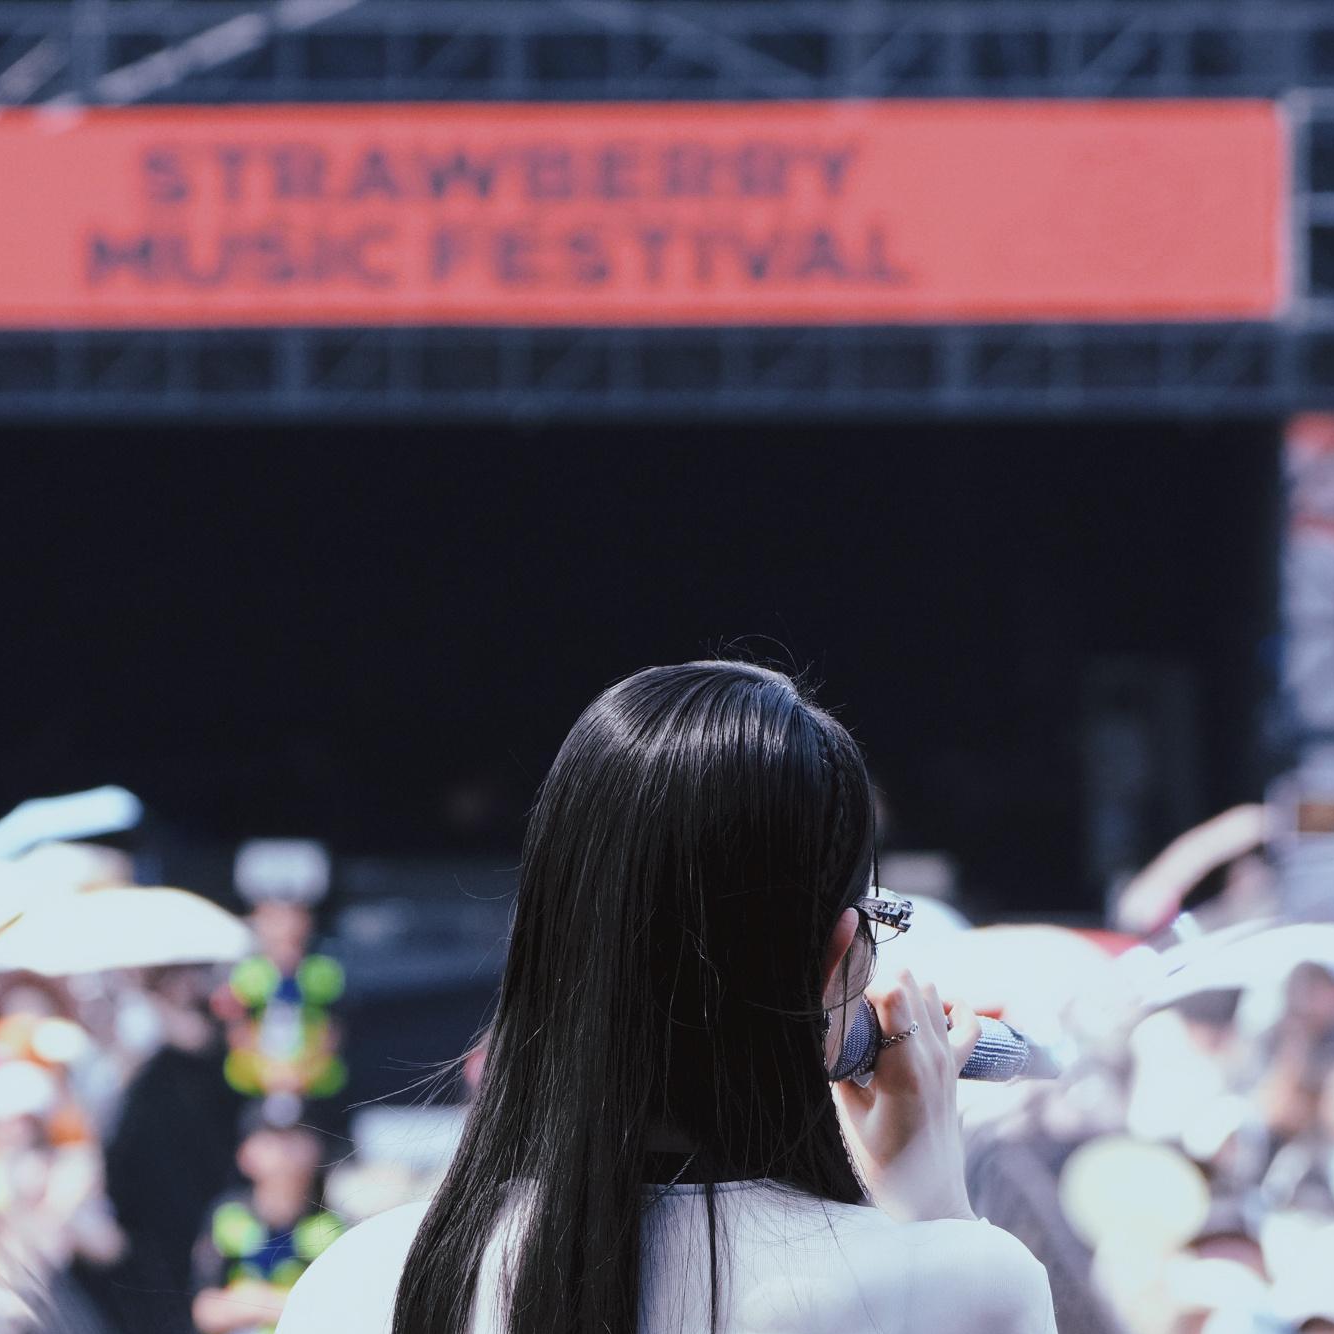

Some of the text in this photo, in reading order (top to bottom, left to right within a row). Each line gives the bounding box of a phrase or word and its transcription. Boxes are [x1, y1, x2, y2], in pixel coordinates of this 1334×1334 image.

[141, 143, 863, 204] STRAWBERRY
[87, 224, 912, 287] MUSIC FESTIVAL
